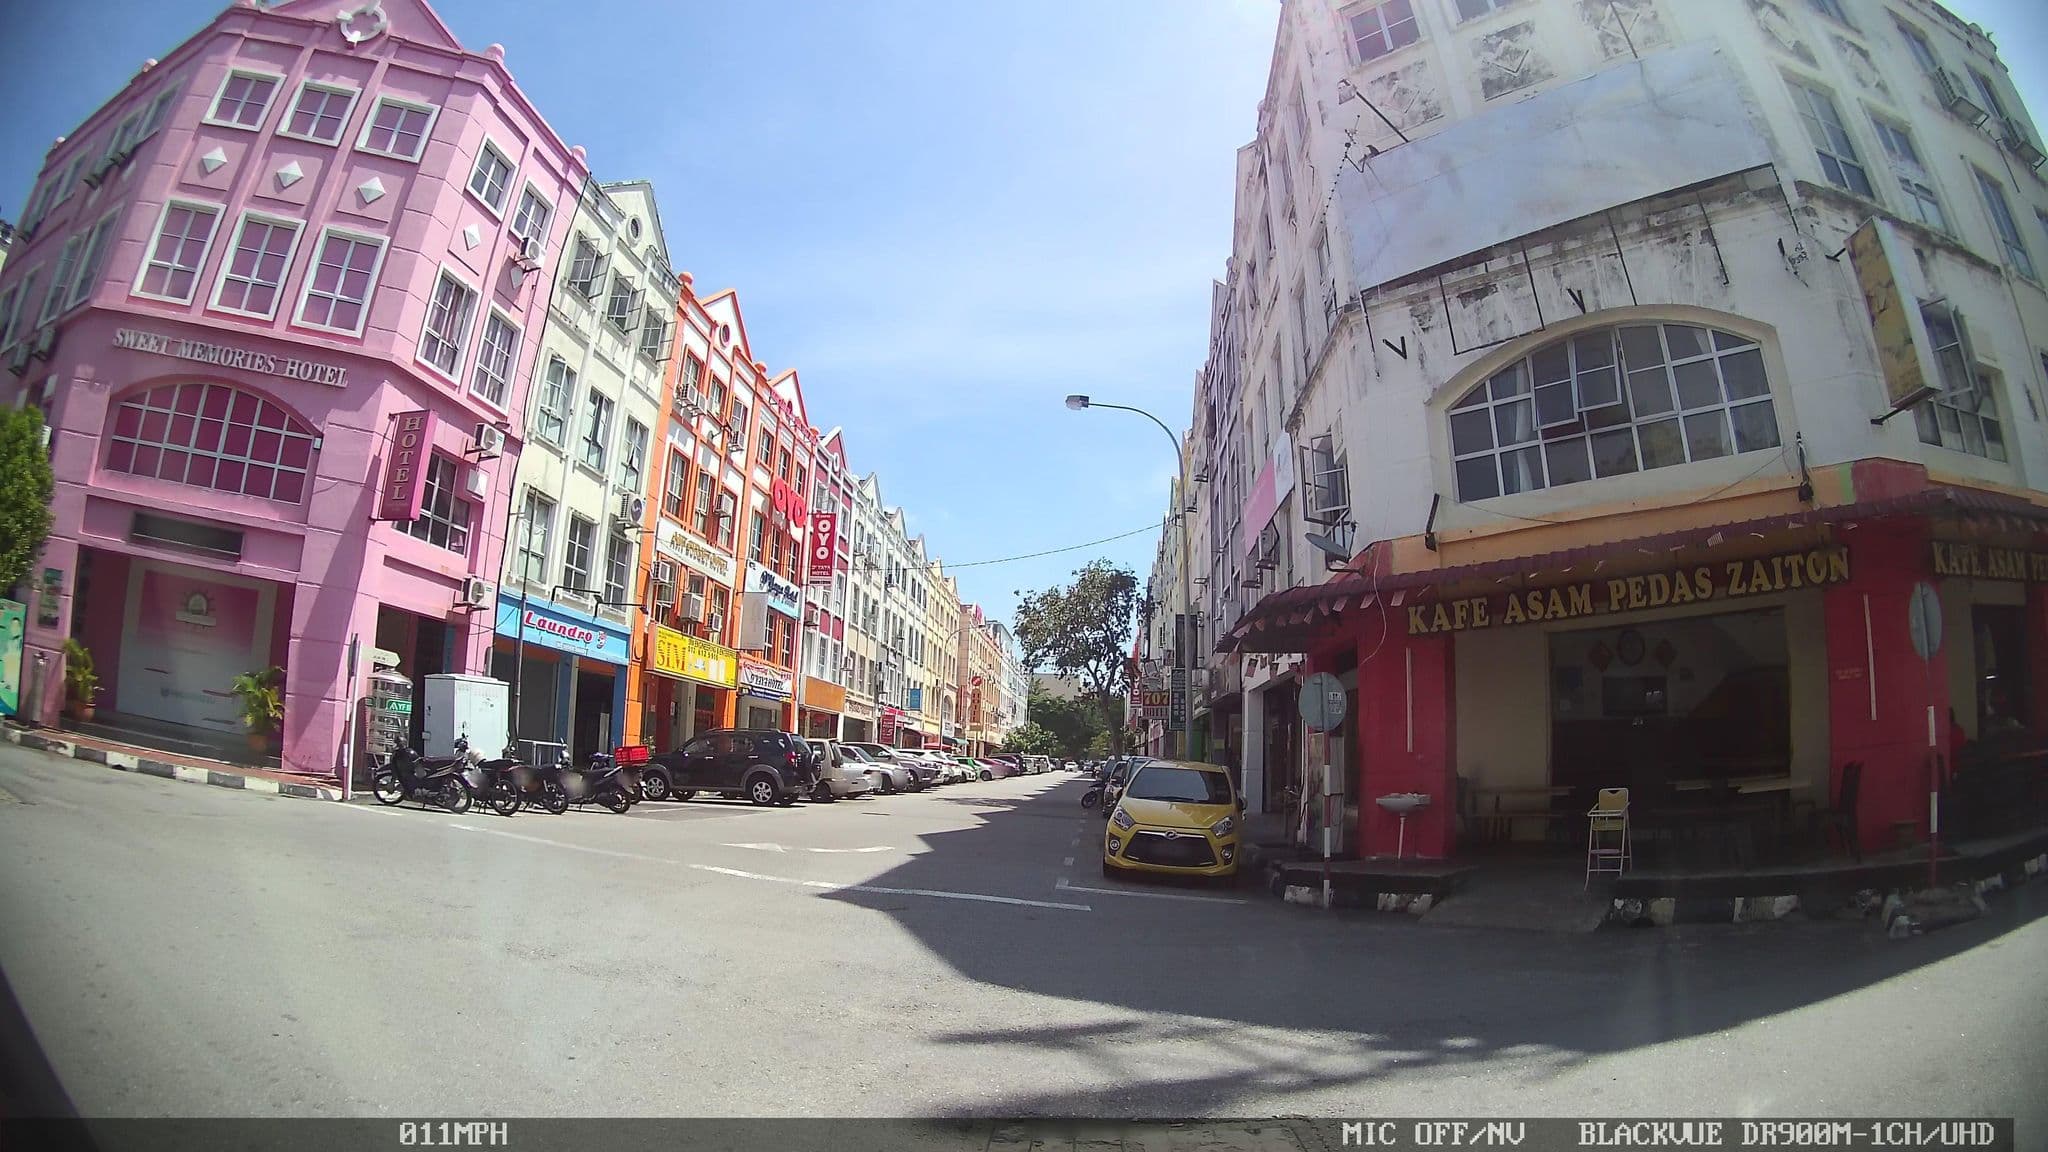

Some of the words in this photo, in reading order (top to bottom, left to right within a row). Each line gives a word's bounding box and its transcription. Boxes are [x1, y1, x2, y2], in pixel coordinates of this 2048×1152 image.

[113, 328, 170, 354] SWEET
[177, 339, 277, 373] MEMORIES
[285, 358, 348, 388] HOTEL
[391, 416, 423, 500] HOTEL
[773, 478, 806, 528] OYO
[816, 519, 831, 560] OYO
[1932, 541, 1981, 576] KAFE
[1988, 548, 2026, 578] ASAM
[1408, 597, 1490, 635] KAFE
[1503, 583, 1594, 625] ASAM
[1607, 567, 1713, 612] PEDAS
[1726, 547, 1850, 596] ZAITON
[1143, 691, 1170, 706] 707
